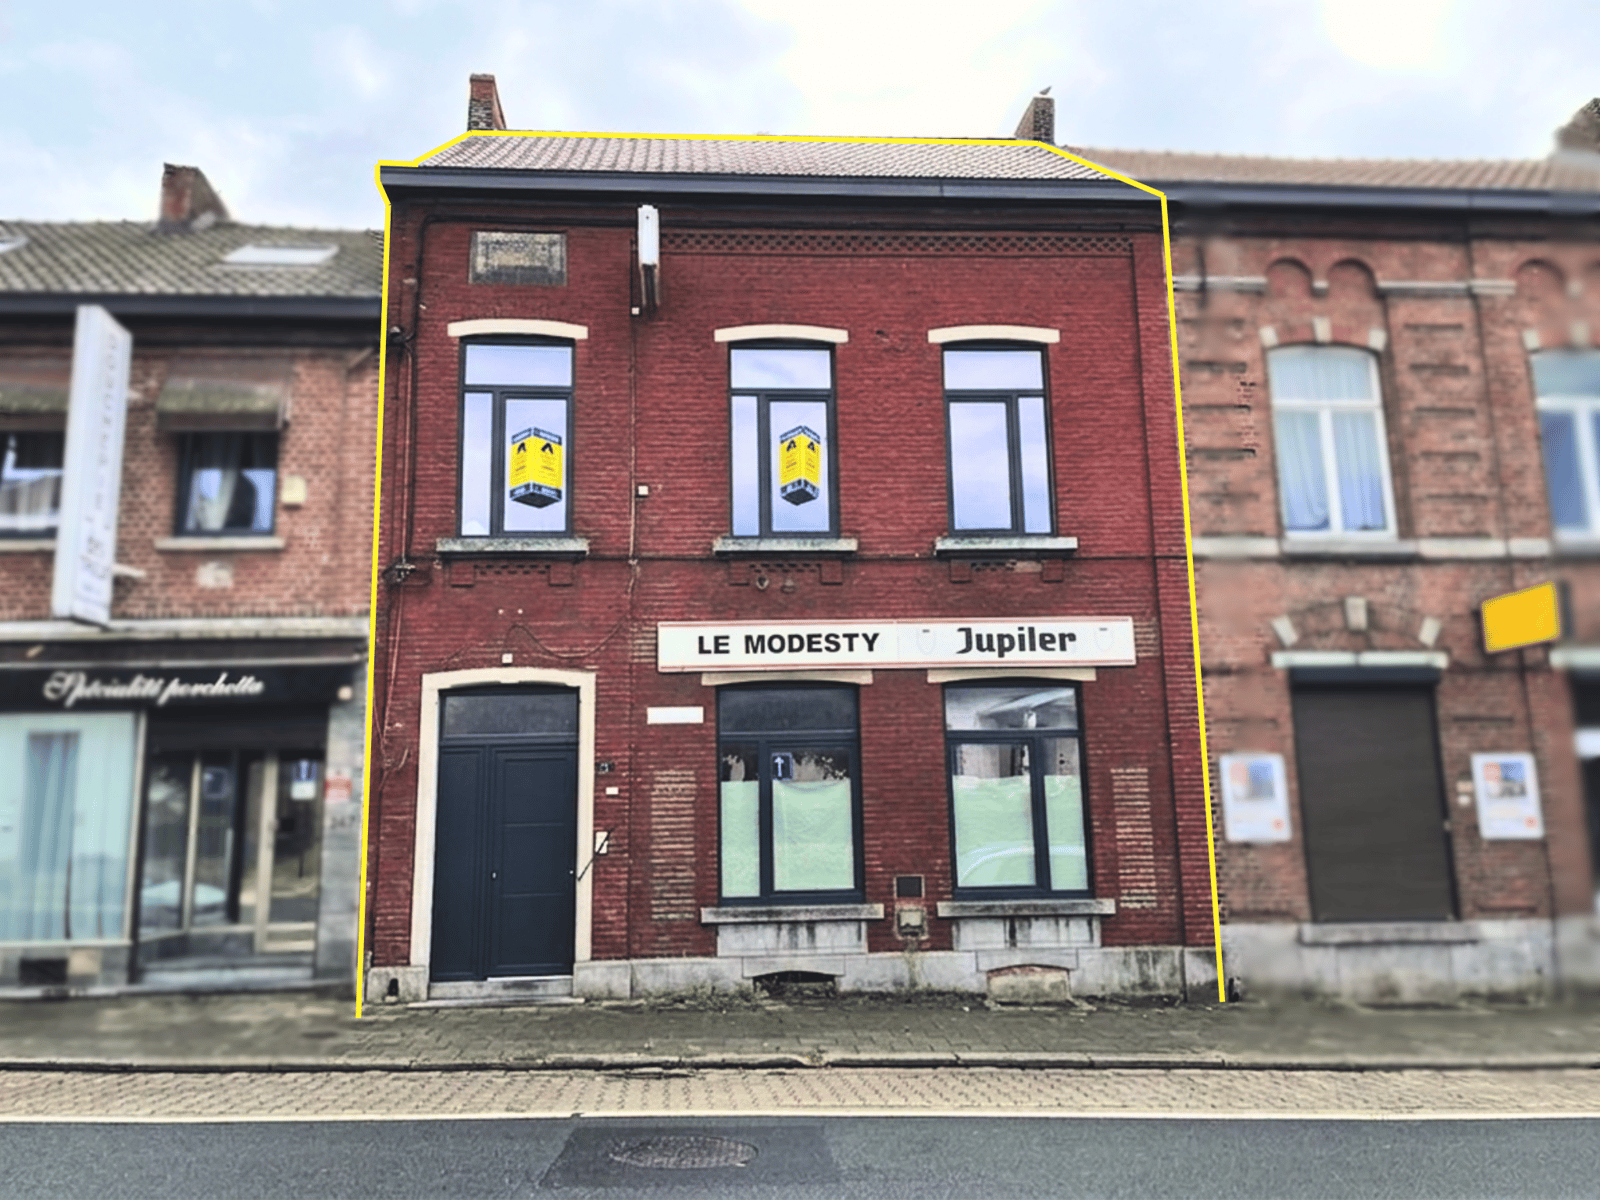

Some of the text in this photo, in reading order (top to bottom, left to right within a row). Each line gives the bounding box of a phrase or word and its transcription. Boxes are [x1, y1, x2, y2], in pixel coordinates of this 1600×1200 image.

[697, 632, 880, 654] LE MODESTY
[955, 626, 1077, 658] Jupiler
[157, 672, 264, 706] porchetta
